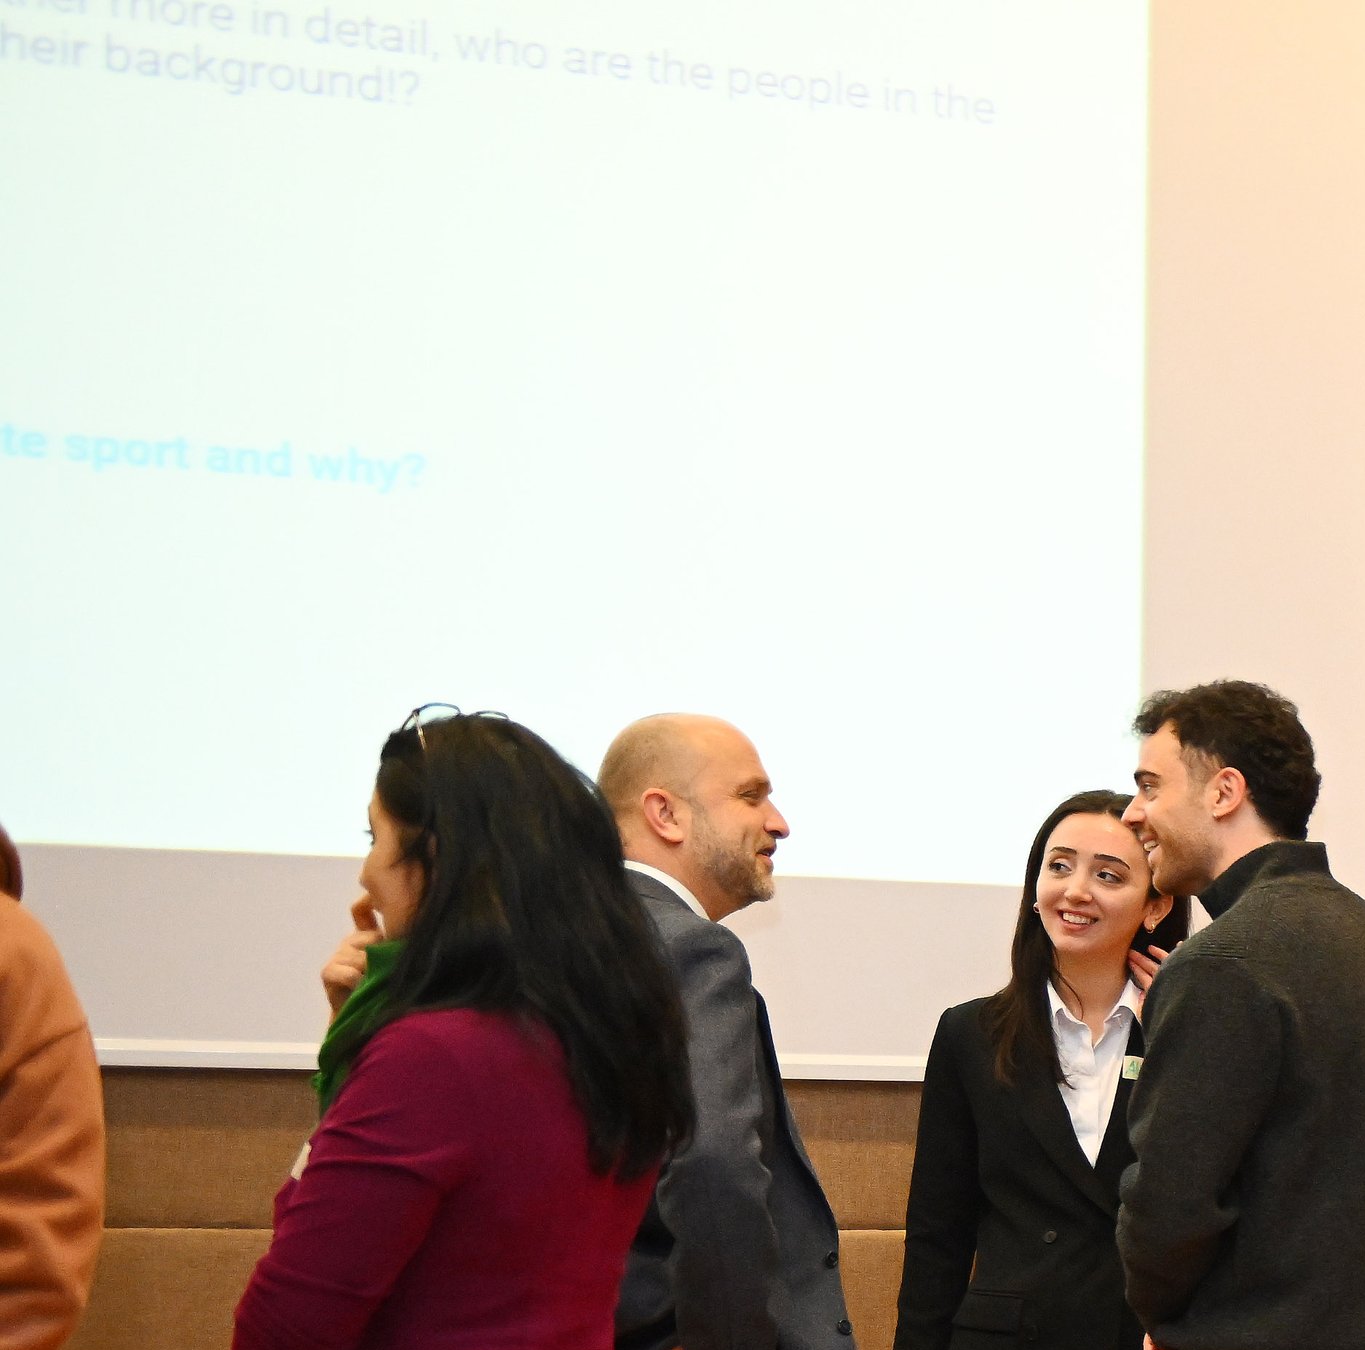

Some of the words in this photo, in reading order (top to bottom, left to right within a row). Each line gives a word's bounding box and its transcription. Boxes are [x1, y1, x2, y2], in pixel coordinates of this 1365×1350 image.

[104, 32, 422, 108] background!?
[250, 1, 291, 39] in
[304, 6, 440, 63] detail,
[453, 26, 549, 69] who
[562, 44, 632, 81] are
[645, 47, 715, 91] the
[727, 69, 871, 112] people
[883, 77, 919, 115] in
[932, 83, 997, 126] the
[64, 433, 192, 473] sport
[205, 440, 293, 479] and
[308, 444, 428, 496] why?
